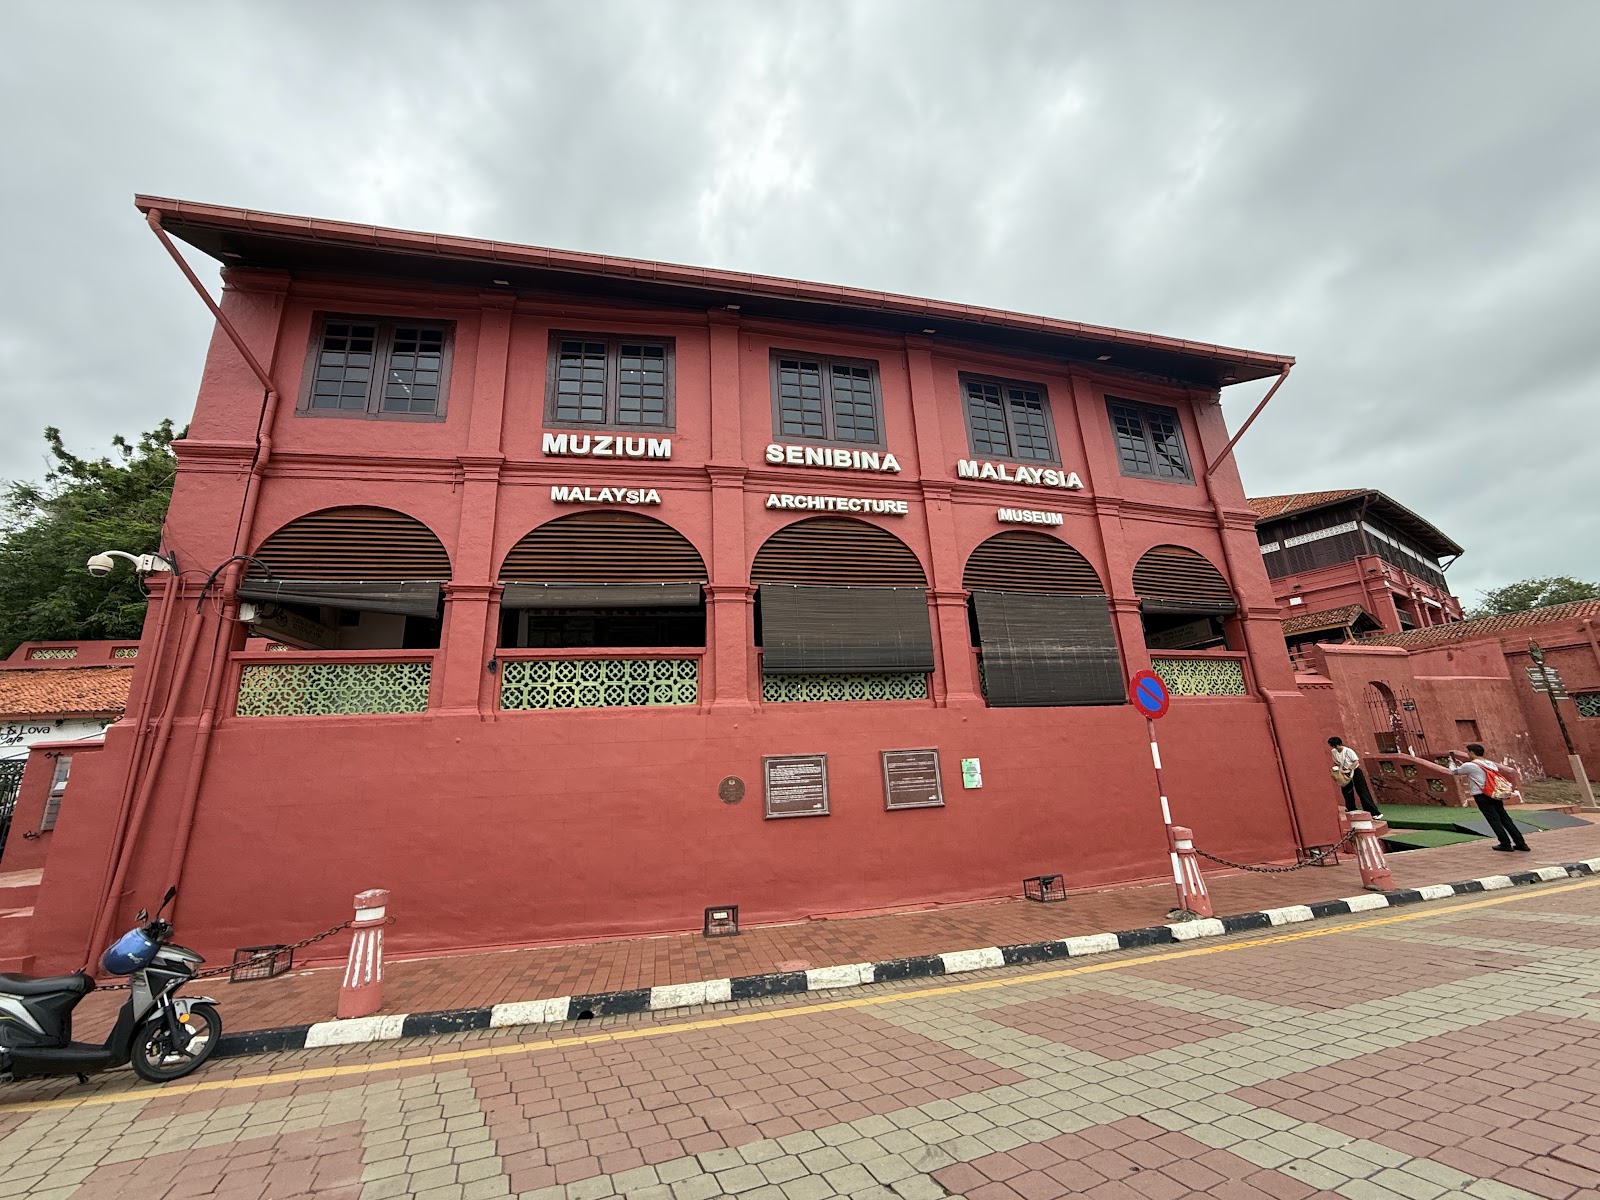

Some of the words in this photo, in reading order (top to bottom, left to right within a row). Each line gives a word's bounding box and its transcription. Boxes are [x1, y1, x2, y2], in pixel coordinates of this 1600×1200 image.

[542, 433, 672, 459] MUZIUM
[766, 444, 901, 473] SENIBINA
[957, 459, 1084, 490] MALAYSIA
[551, 486, 661, 505] MALAYSIA
[766, 493, 909, 514] ARCHITECTURE
[997, 508, 1064, 526] MUSEUM
[7, 725, 17, 735] &
[20, 725, 50, 735] Lova
